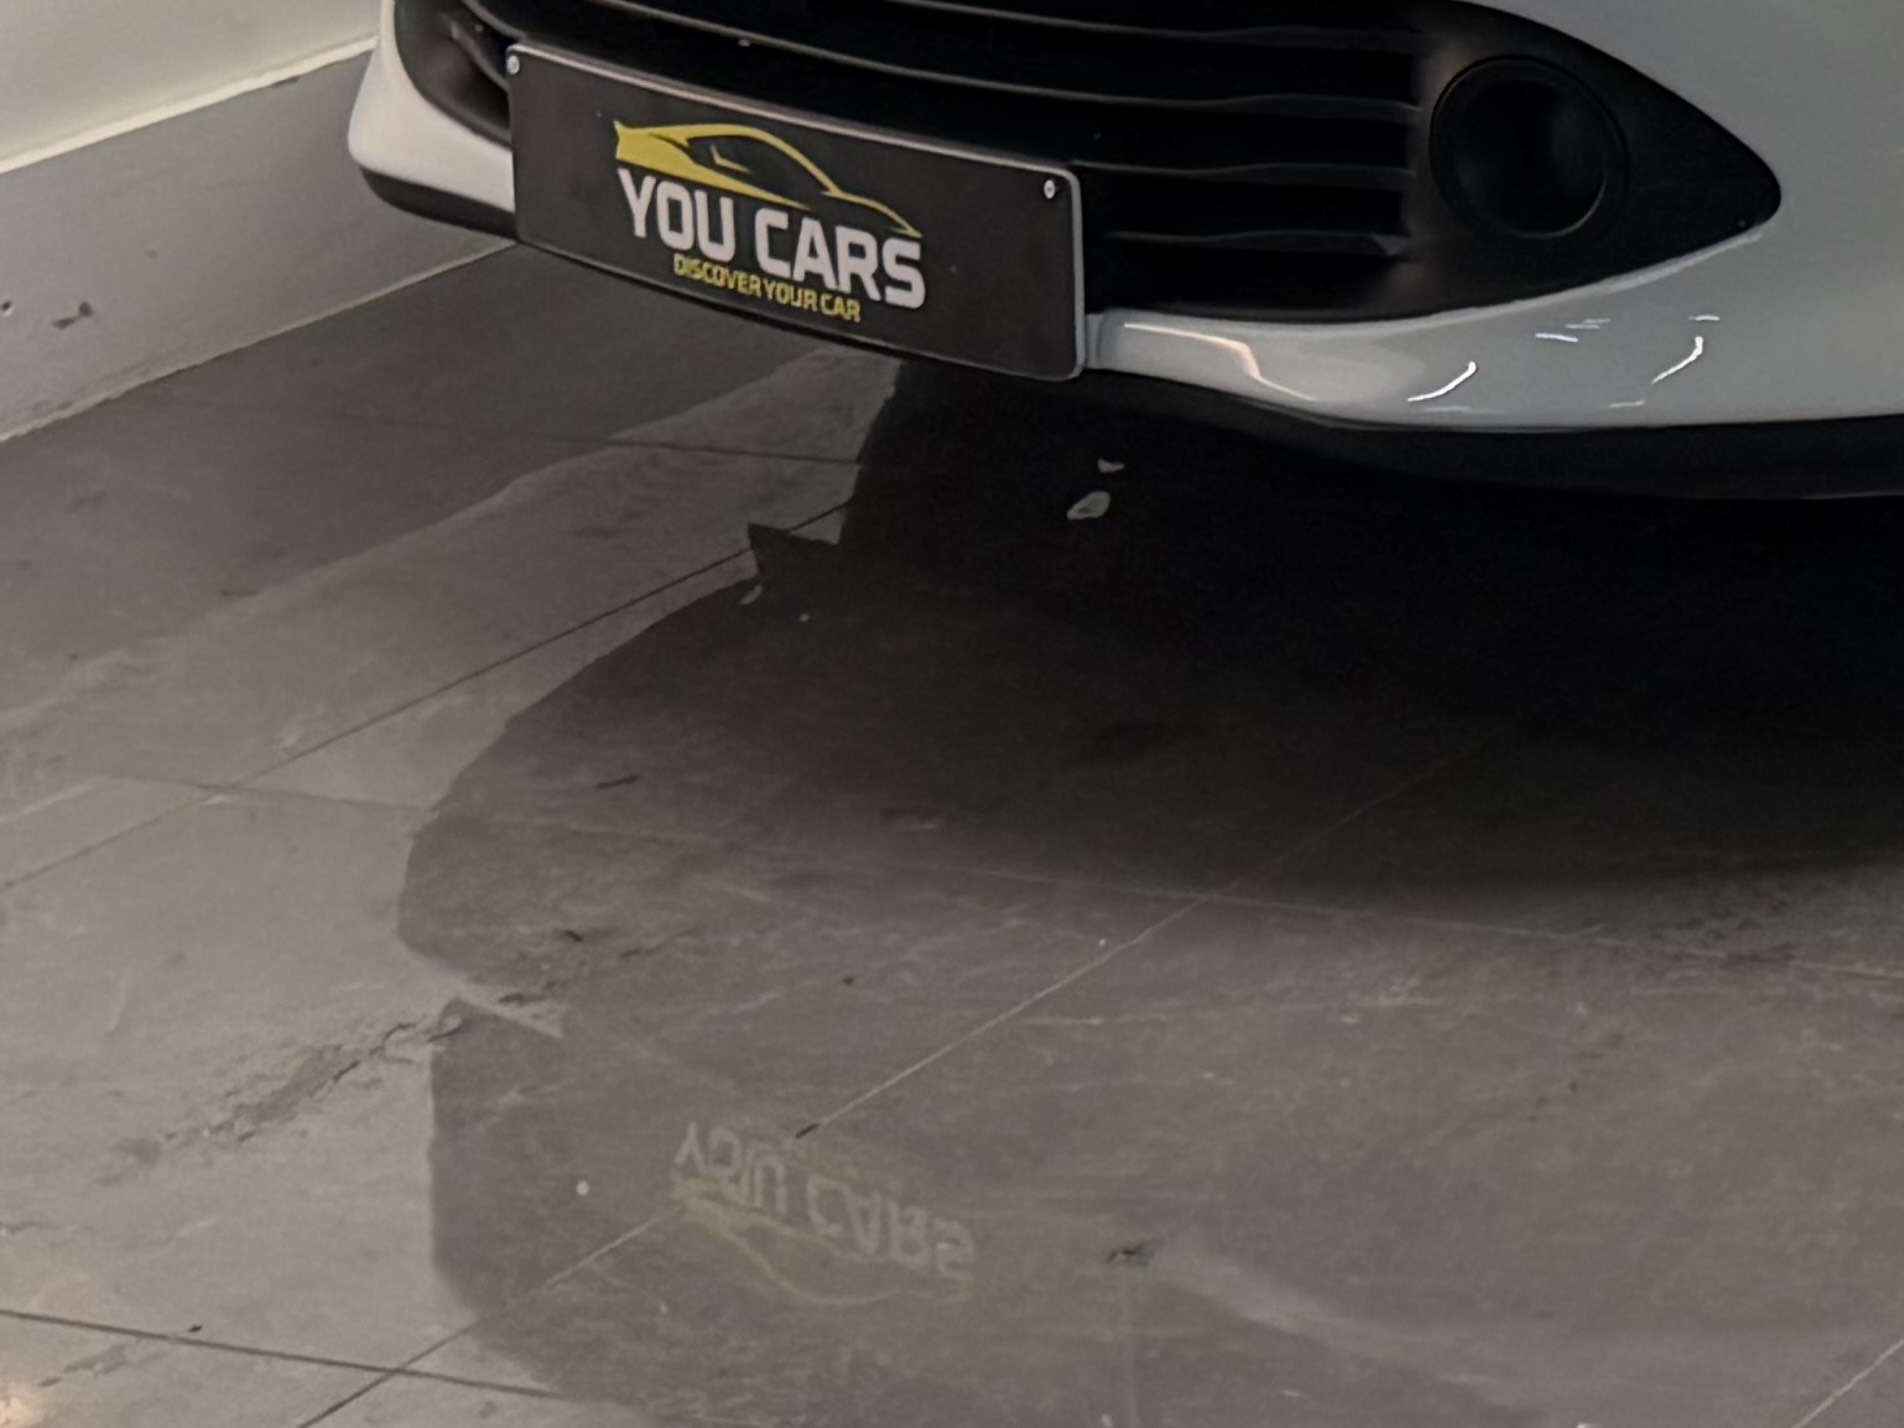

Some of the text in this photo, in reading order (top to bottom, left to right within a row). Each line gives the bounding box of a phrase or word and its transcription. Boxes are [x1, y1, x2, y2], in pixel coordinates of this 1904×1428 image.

[617, 168, 926, 309] YOU CARS
[673, 252, 861, 323] DISCOVER YOUR CAR
